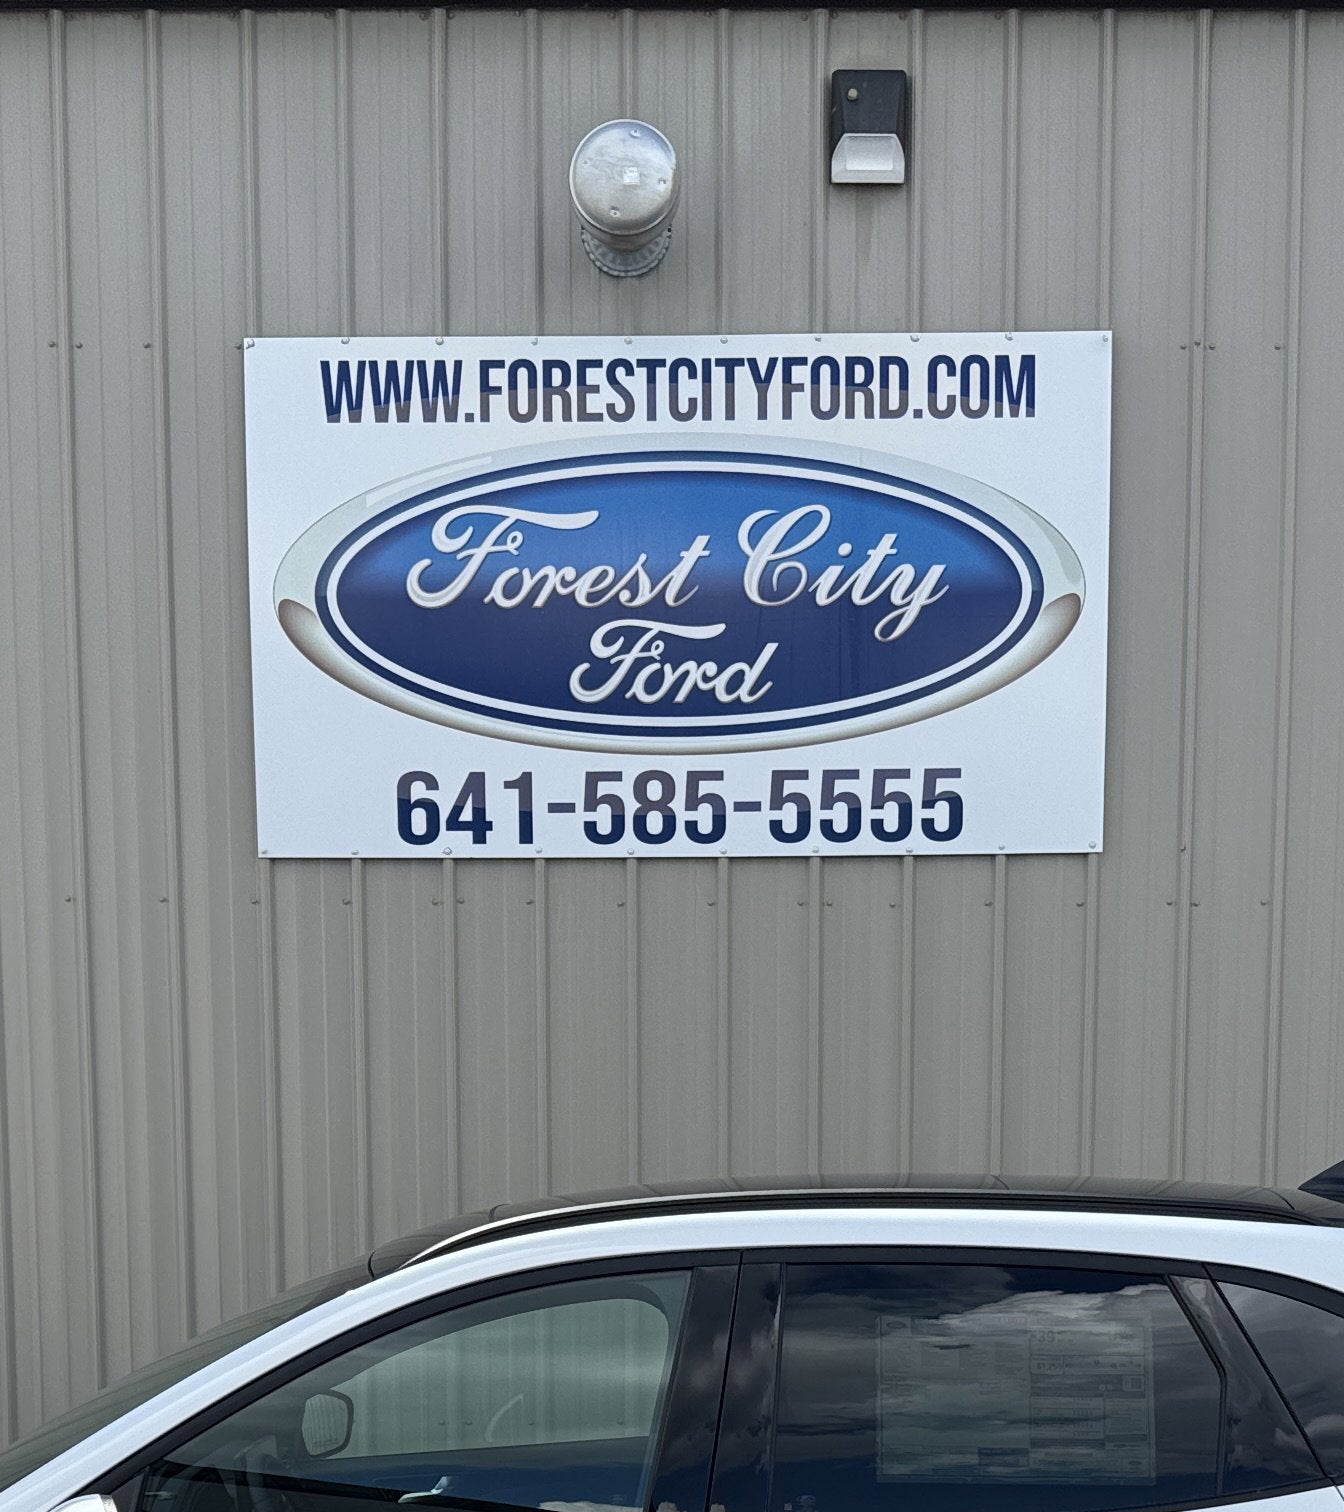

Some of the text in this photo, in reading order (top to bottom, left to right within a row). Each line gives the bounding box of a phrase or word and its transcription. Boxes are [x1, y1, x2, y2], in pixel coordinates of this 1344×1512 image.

[320, 354, 1036, 423] WWW.FORESTCITYFORD.COM
[404, 503, 950, 643] Forest City
[568, 618, 780, 705] Ford
[396, 767, 964, 845] 641-585-5555
